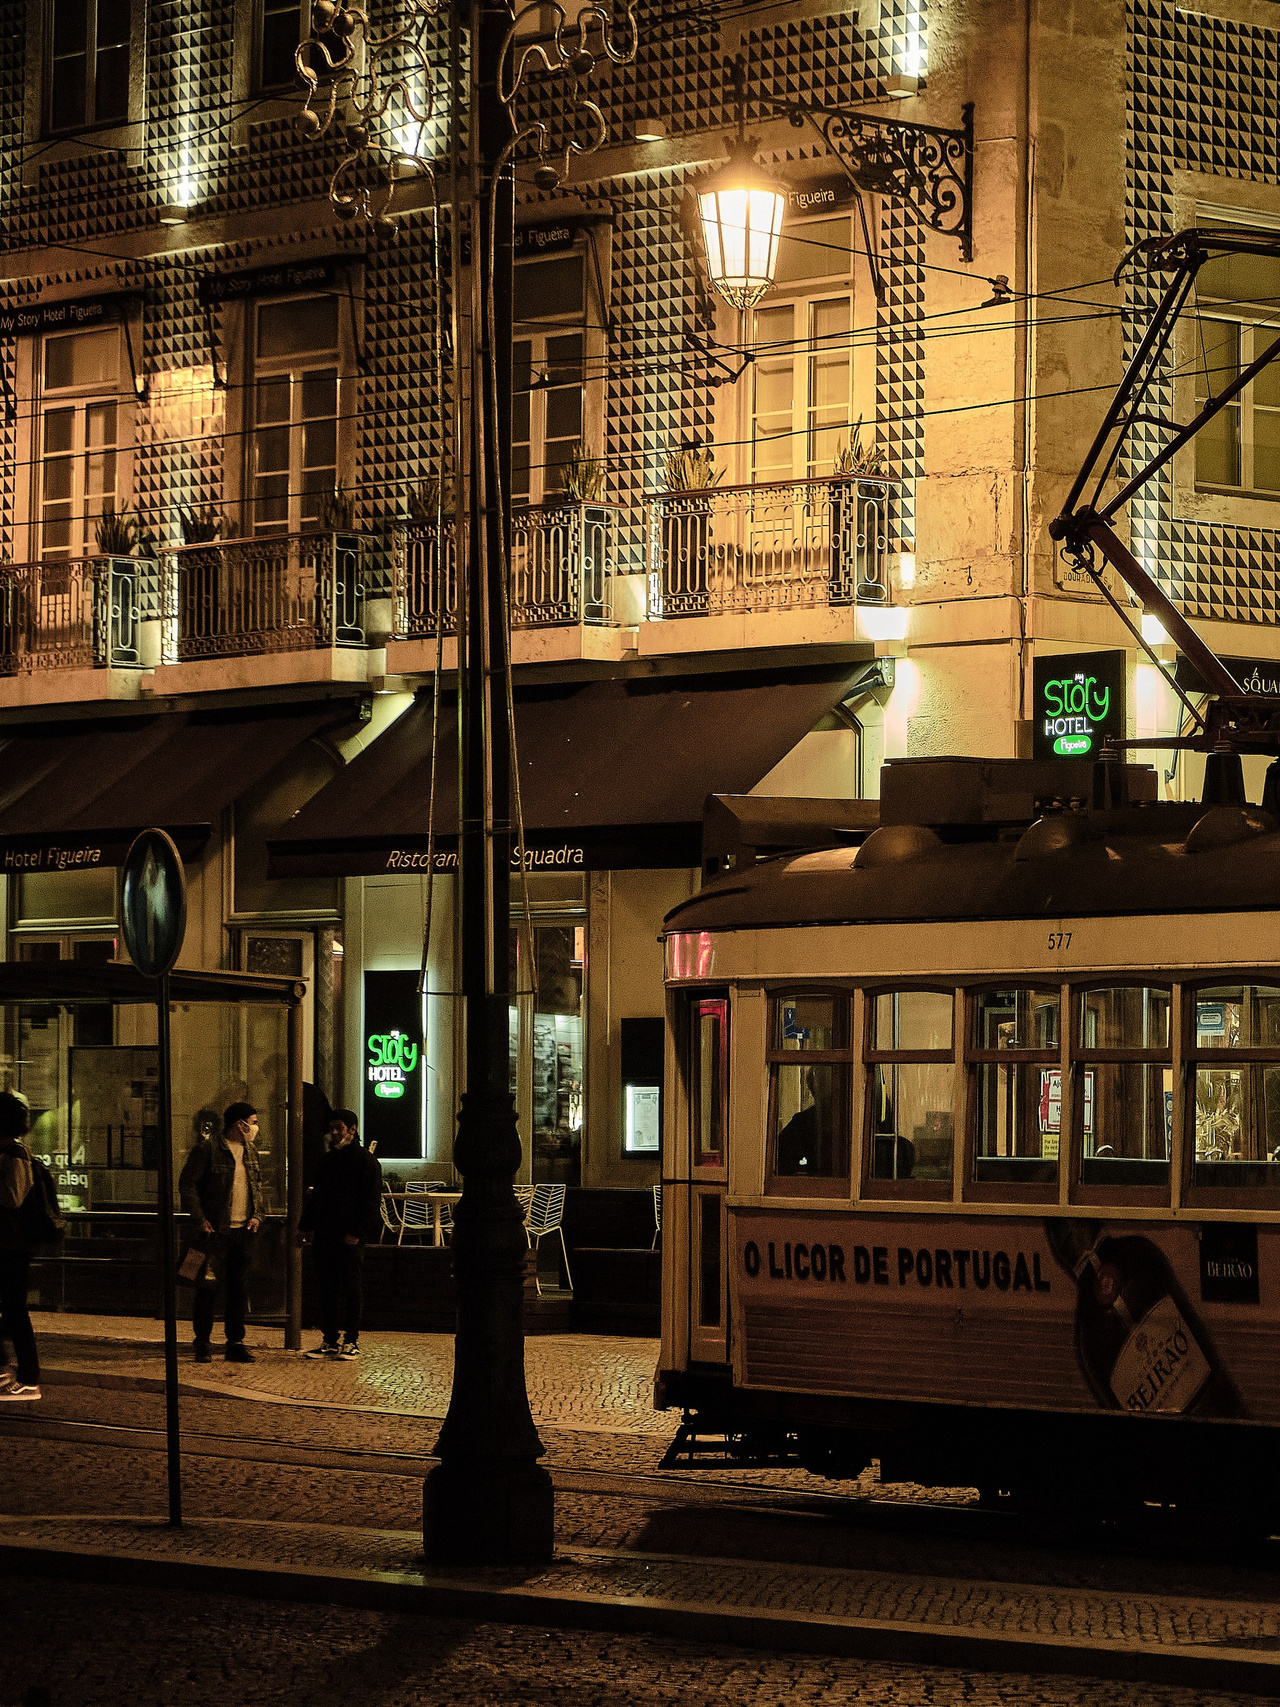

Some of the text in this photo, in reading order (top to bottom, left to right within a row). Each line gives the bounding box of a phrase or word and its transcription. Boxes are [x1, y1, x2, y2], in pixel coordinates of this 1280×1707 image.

[788, 188, 835, 209] Figueira
[528, 226, 570, 247] Figueira
[1, 302, 103, 331] My Story Hotel Figueira
[1044, 677, 1109, 721] Story
[1045, 716, 1093, 736] HOTEL
[4, 846, 101, 869] Hotel Figueira
[385, 844, 584, 870] Ristoran Squadra
[1048, 932, 1072, 950] 577
[368, 1033, 418, 1073] Story
[368, 1065, 407, 1082] HOTEL
[744, 1241, 1051, 1293] O LICOR DE PORTUGAL
[1206, 1260, 1254, 1279] BEIRÃO
[1127, 1329, 1189, 1411] BEIRÃO
